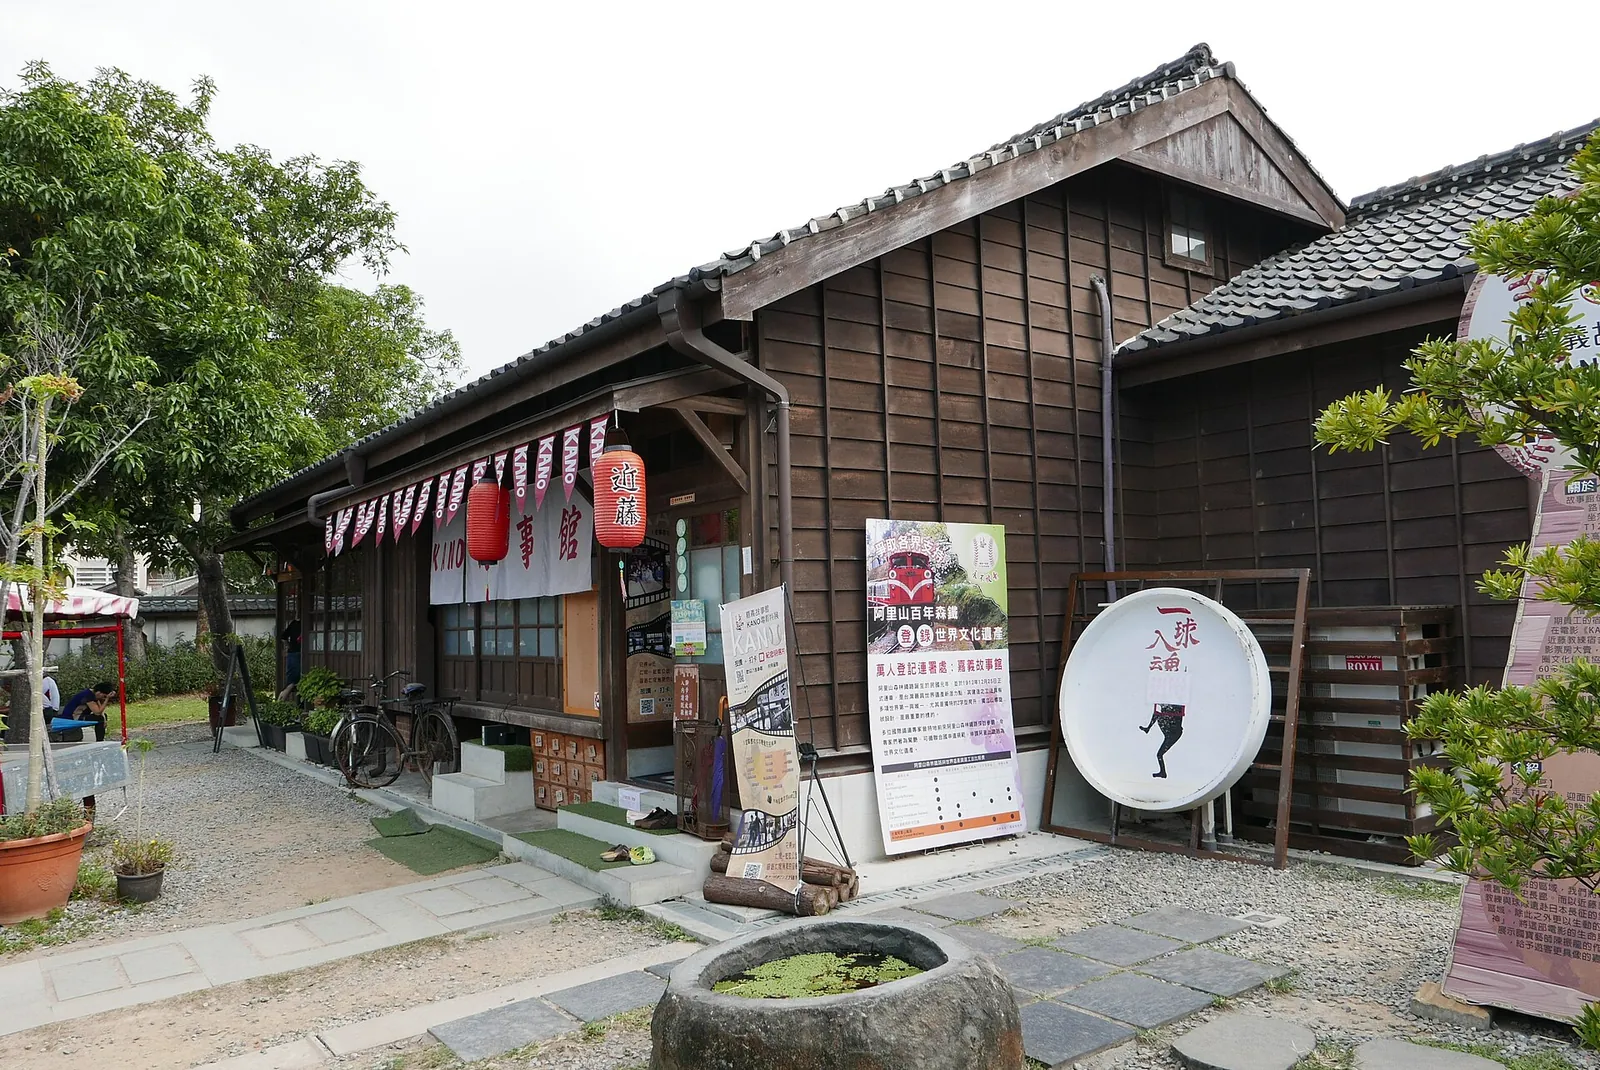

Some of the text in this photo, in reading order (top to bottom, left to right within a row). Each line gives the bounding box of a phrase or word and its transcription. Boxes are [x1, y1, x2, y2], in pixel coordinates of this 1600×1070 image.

[514, 445, 529, 498] KANO
[536, 435, 556, 490] KANO
[565, 427, 581, 485] KANO
[399, 485, 417, 526] KANO
[414, 479, 433, 522] KANO
[436, 473, 450, 519] KANO
[449, 466, 469, 512] KANO
[609, 462, 642, 528] 近藤
[1567, 480, 1595, 494] 關於
[334, 507, 353, 541] KANO
[360, 499, 378, 535] KANO
[378, 494, 391, 534] KANO
[873, 606, 959, 622] 阿里山百年森鐵
[1347, 662, 1382, 671] ROYAL
